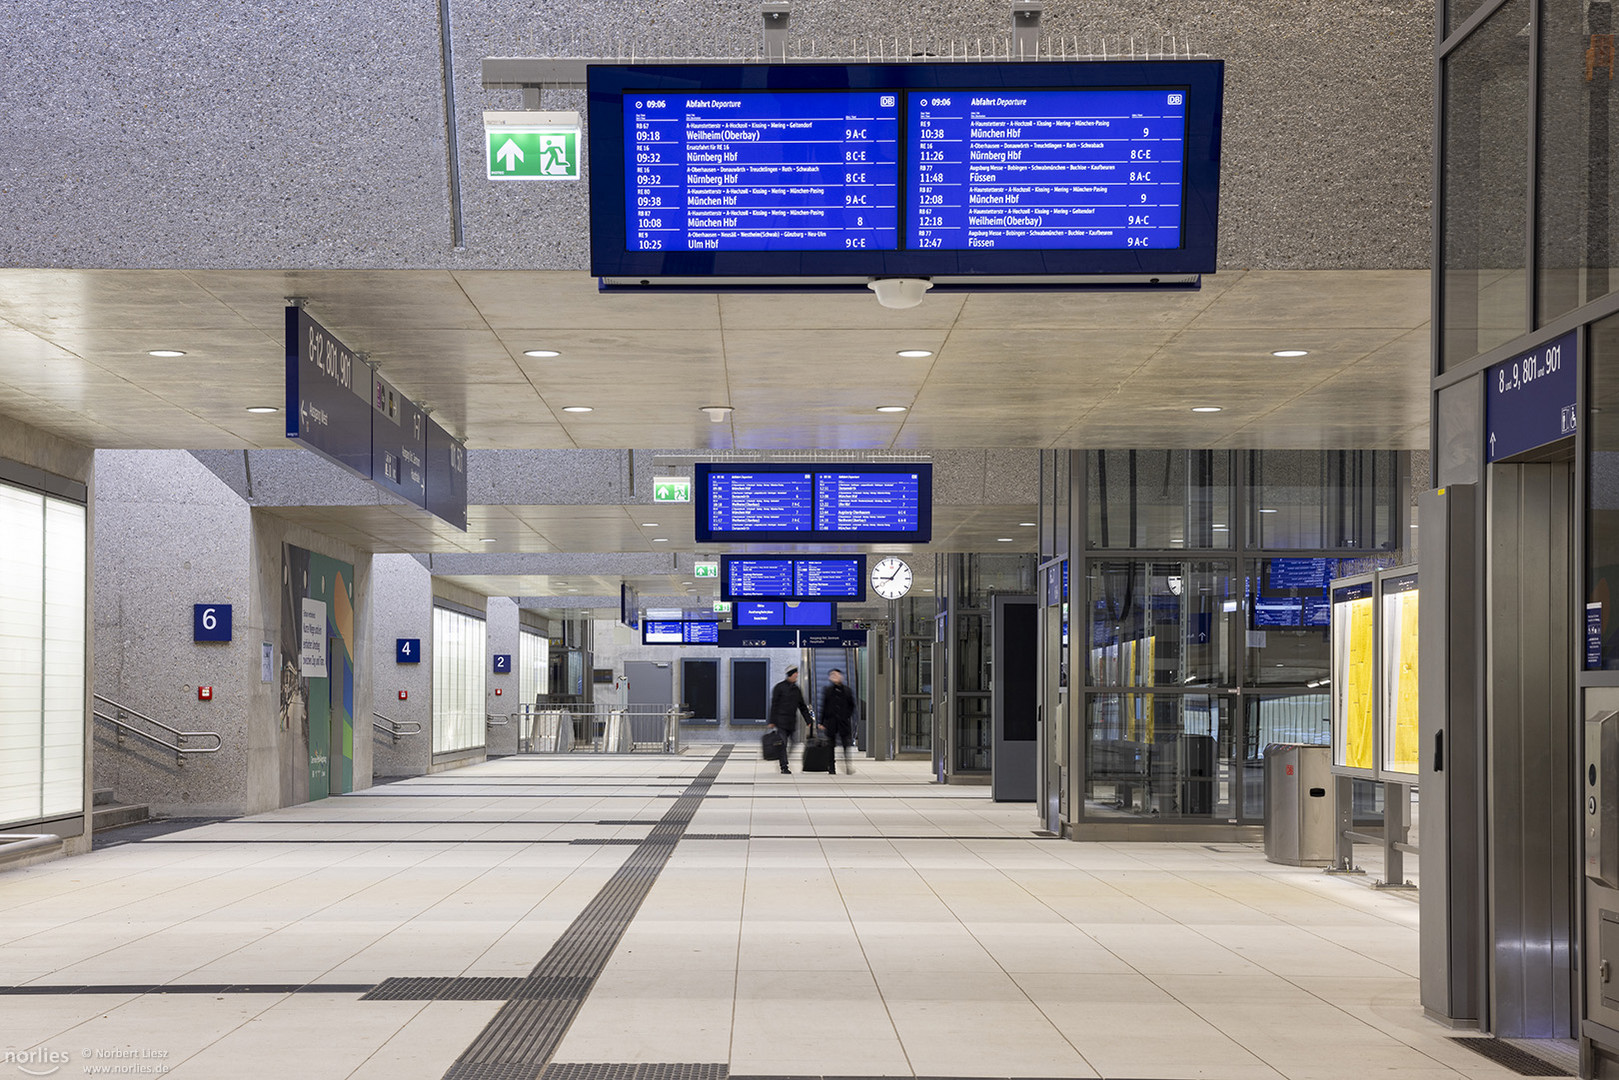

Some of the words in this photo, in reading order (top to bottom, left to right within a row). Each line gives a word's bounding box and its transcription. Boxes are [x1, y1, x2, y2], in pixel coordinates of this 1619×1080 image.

[881, 97, 894, 106] DB
[997, 98, 1026, 107] Departure
[1169, 95, 1181, 104] DB
[712, 100, 741, 109] Departure
[636, 131, 660, 141] 09:18
[686, 130, 760, 141] Weilheim(Oberbay)
[846, 130, 851, 139] 9
[853, 129, 866, 139] A-C
[921, 129, 944, 139] 10:38
[971, 129, 1005, 138] München
[1007, 128, 1021, 138] Hbf
[1144, 128, 1149, 137] 9
[637, 153, 660, 162] 09:32
[687, 152, 722, 163] Nürnberg
[724, 152, 738, 161] Hbf
[846, 152, 851, 160] 8
[853, 151, 866, 161] C-E
[921, 151, 944, 160] 11:26
[970, 151, 1005, 161] Nürnberg
[1008, 150, 1021, 160] Hbf
[1131, 150, 1136, 159] 8
[1138, 150, 1151, 159] C-E
[637, 175, 661, 184] 09:32
[688, 174, 722, 185] Nürnberg
[724, 174, 738, 183] Hbf
[846, 174, 851, 182] 8
[853, 173, 866, 182] C-E
[920, 173, 943, 182] 11:48
[970, 172, 996, 182] Füssen
[1130, 172, 1135, 181] 8
[1137, 172, 1151, 181] A-C
[638, 197, 661, 206] 09:38
[688, 196, 721, 205] München
[723, 196, 737, 205] Hbf
[846, 195, 851, 204] 9
[853, 195, 866, 204] A-C
[920, 195, 943, 204] 12:08
[970, 194, 1003, 204] München
[1005, 194, 1019, 203] Hbf
[1141, 194, 1146, 203] 9
[639, 218, 662, 228] 10:08
[688, 218, 722, 227] München
[723, 218, 737, 227] Hbf
[857, 217, 863, 226] 8
[920, 217, 942, 226] 12:18
[969, 216, 1042, 227] Weilheim(Oberbay)
[1128, 216, 1134, 225] 9
[1135, 216, 1149, 224] A-C
[639, 240, 662, 249] 10:25
[688, 240, 703, 248] Ulm
[705, 239, 719, 248] Hbf
[846, 238, 851, 248] 9
[853, 238, 866, 248] C-E
[920, 238, 942, 247] 12:47
[969, 238, 994, 247] Füssen
[1128, 238, 1133, 246] 9
[1134, 237, 1148, 246] A-C
[326, 340, 339, 386] 801,
[340, 351, 351, 389] 901
[1498, 369, 1505, 393] 8
[1513, 363, 1521, 390] 9,
[1522, 355, 1537, 383] 801
[1546, 345, 1560, 375] 901
[202, 608, 217, 630] 6
[401, 642, 412, 656] 4
[497, 657, 504, 667] 2
